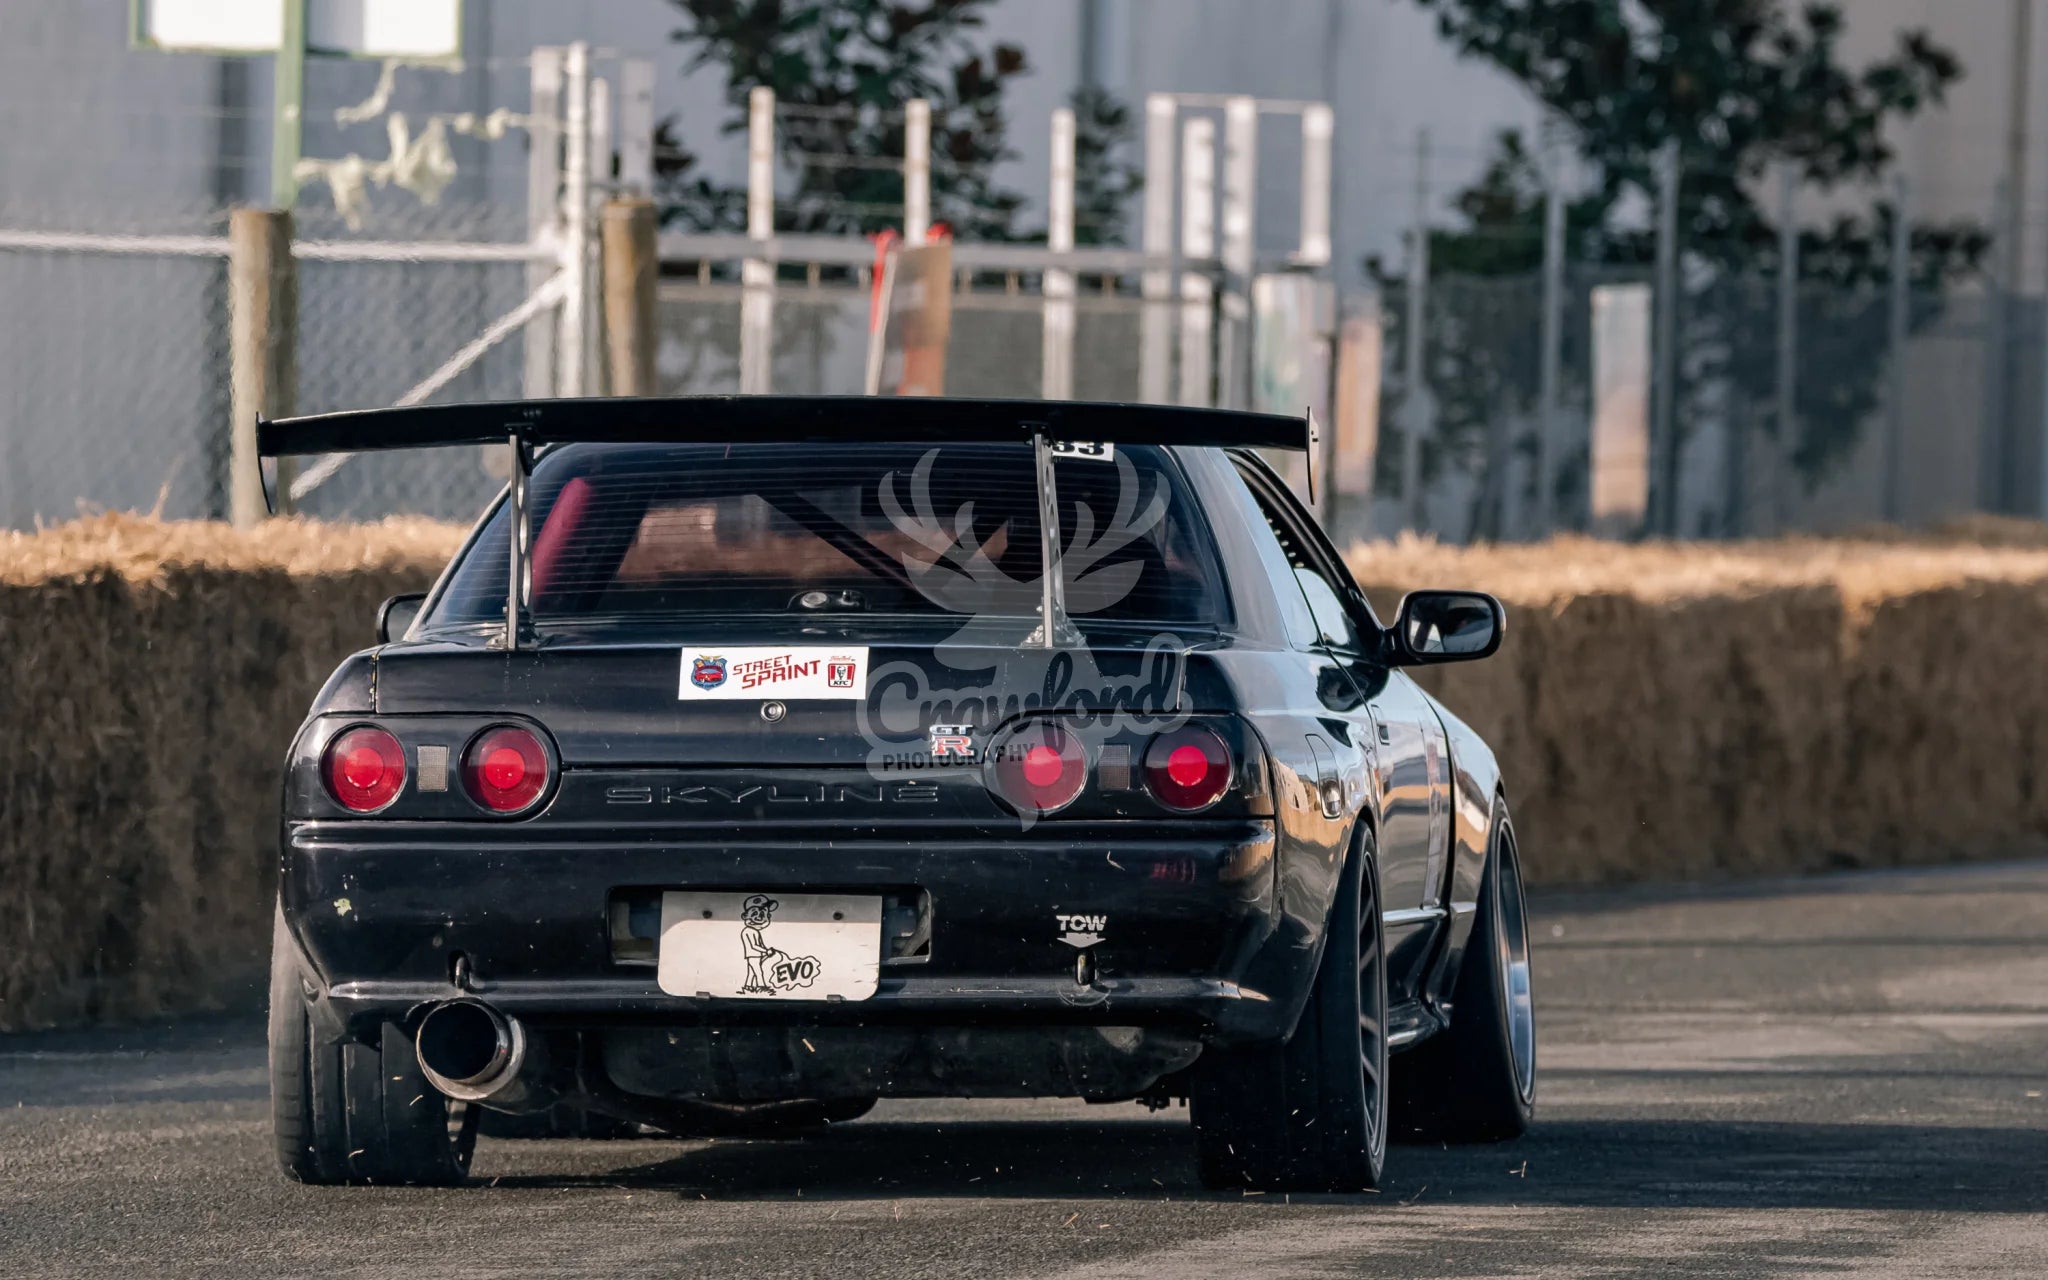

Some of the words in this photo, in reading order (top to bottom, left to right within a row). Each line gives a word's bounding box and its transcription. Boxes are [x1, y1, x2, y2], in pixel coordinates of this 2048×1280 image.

[732, 654, 792, 676] STREET
[741, 659, 821, 690] SPRINT
[929, 724, 973, 735] GT
[930, 735, 975, 757] R
[606, 786, 939, 804] SKYLINE
[776, 960, 815, 982] EVO
